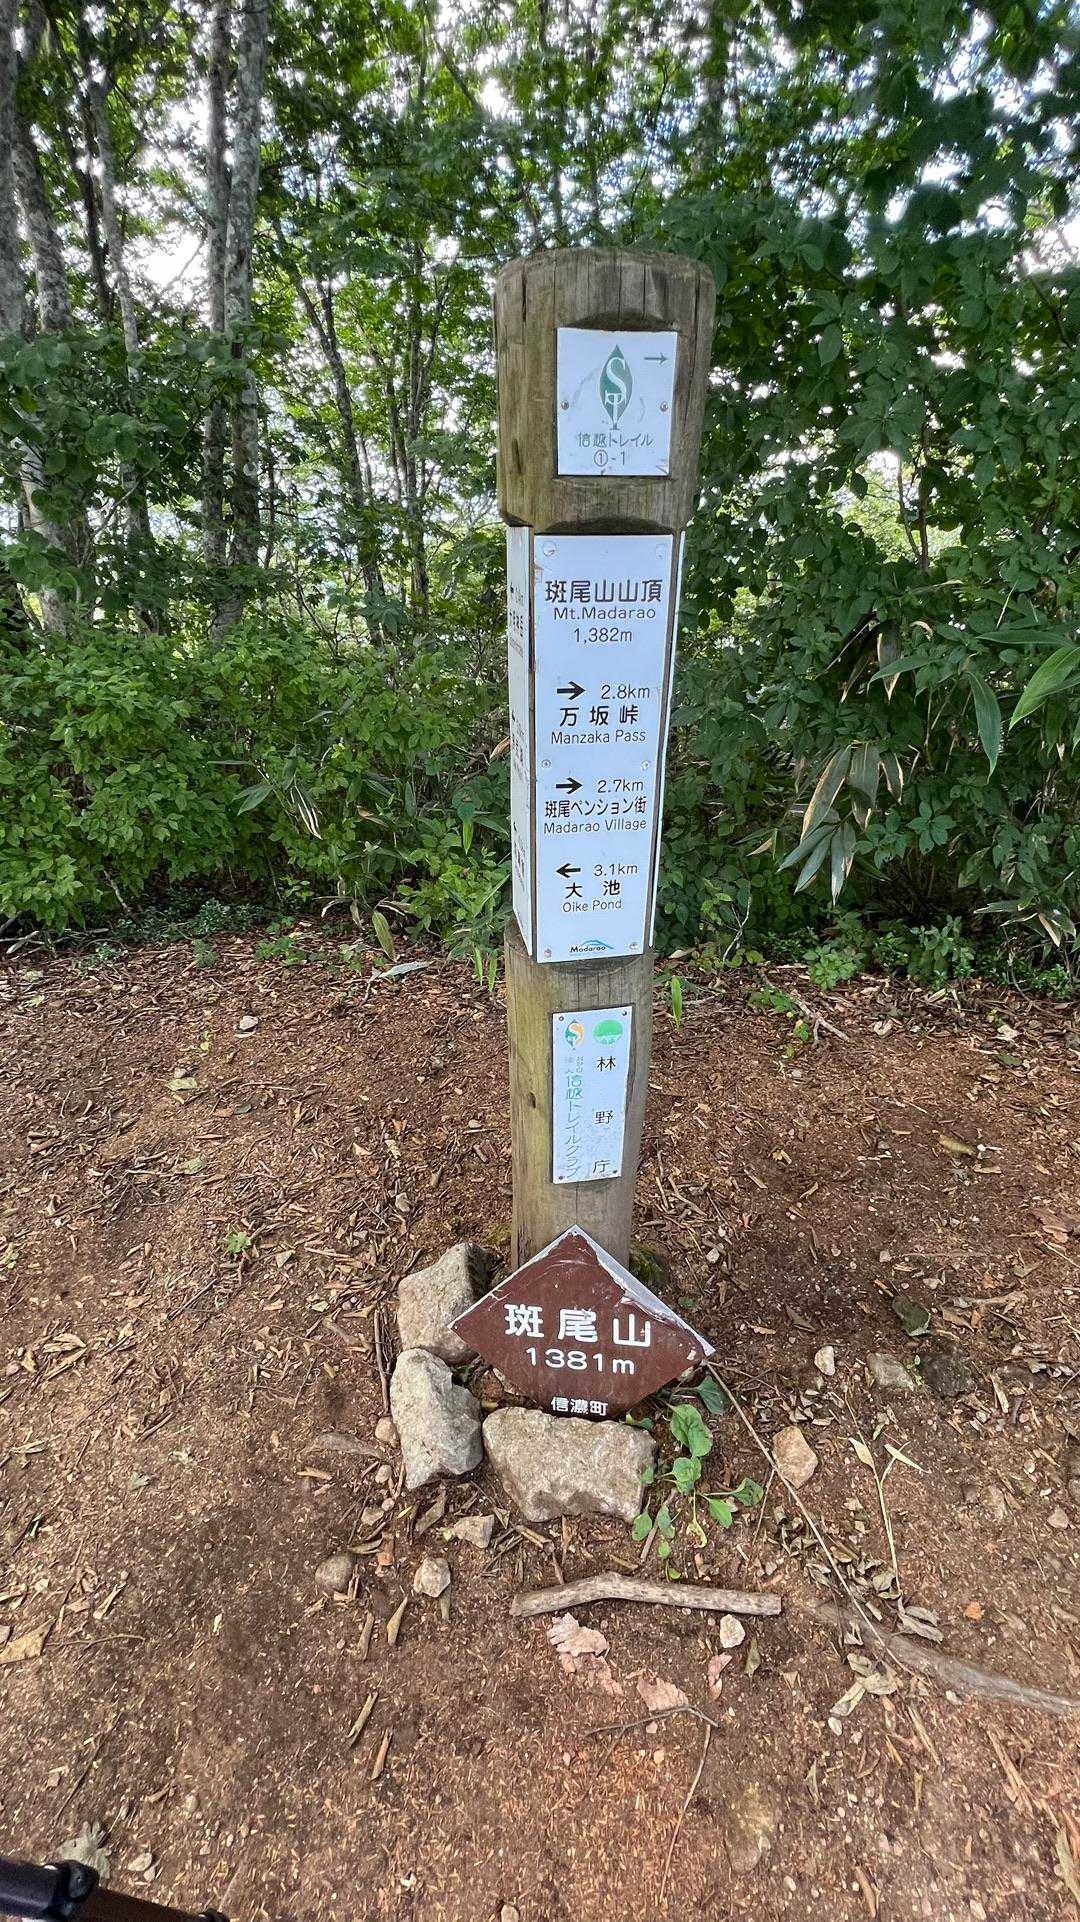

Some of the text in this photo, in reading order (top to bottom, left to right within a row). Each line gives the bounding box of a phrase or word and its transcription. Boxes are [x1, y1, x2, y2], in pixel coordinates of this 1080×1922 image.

[578, 432, 653, 448] 信越トレイル
[545, 579, 663, 603] 斑尾山山頂
[553, 606, 656, 620] Mt.Madarao
[574, 627, 633, 644] 1,382m
[601, 684, 650, 699] 2.8km
[559, 705, 639, 727] 万坂峠
[551, 729, 647, 745] Manzaka Pass
[597, 779, 644, 794] 2.7km
[545, 796, 647, 818] 斑尾ペンション街
[544, 818, 647, 834] Madarao Village
[594, 863, 638, 877] 3.1km
[565, 881, 621, 899] 大池
[562, 899, 622, 913] Oike Pond
[569, 945, 607, 953] Madarao
[592, 1056, 616, 1174] 林野庁
[504, 1303, 651, 1348] 斑尾山
[525, 1347, 635, 1375] 1381m
[550, 1396, 609, 1416] 信濃町
